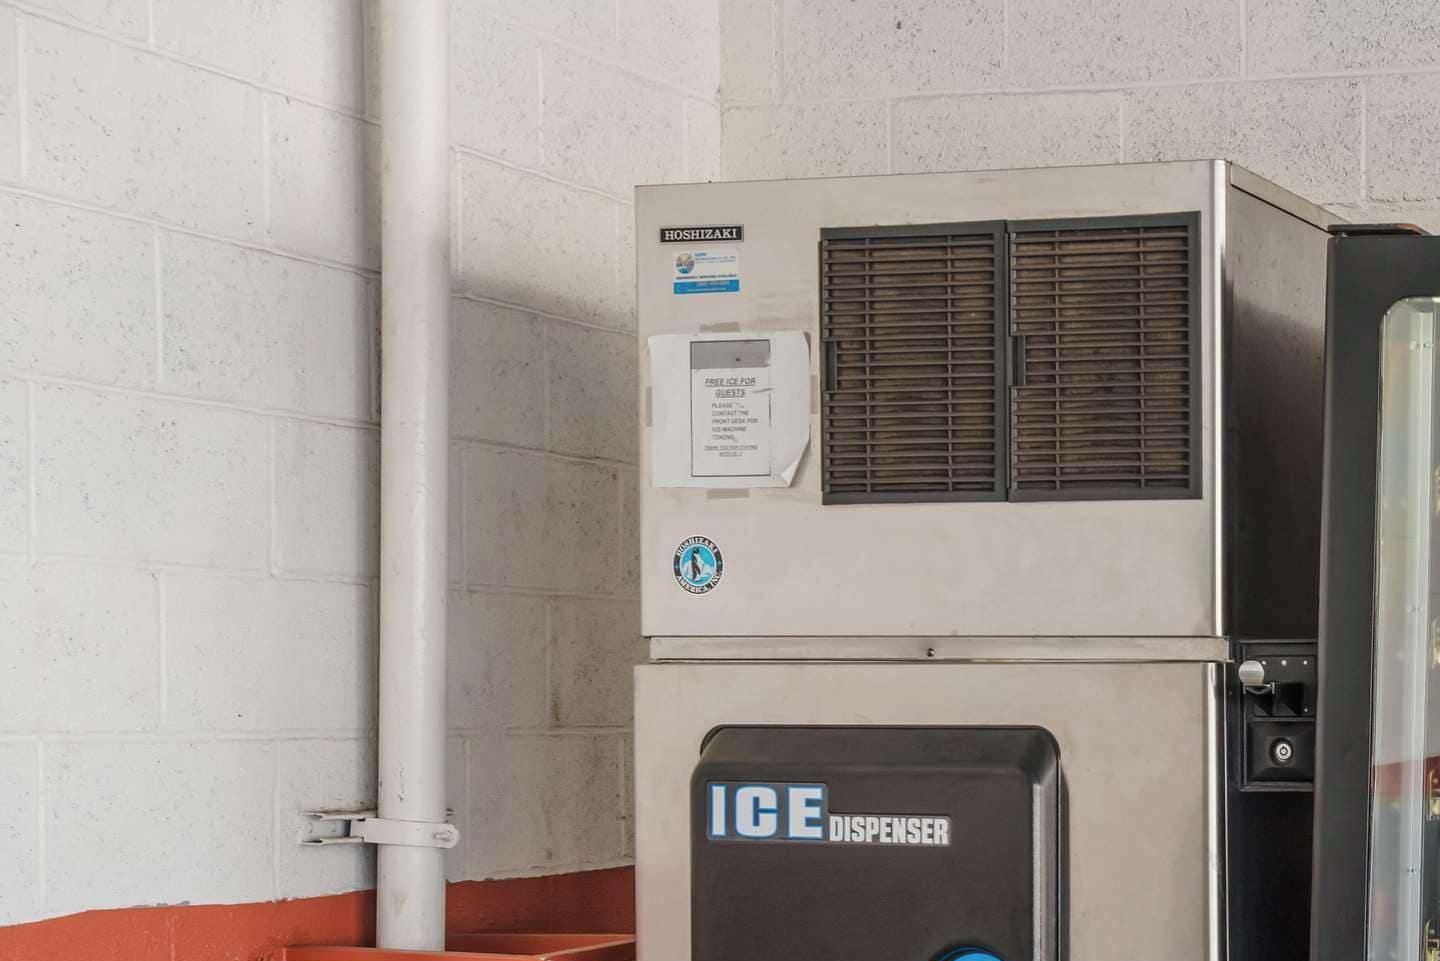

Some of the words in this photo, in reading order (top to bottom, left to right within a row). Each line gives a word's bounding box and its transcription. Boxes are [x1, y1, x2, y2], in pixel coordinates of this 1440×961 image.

[664, 228, 737, 241] HOSHIZAKI
[705, 378, 724, 386] FREE
[740, 377, 756, 385] FOR
[715, 388, 746, 398] GUESTS
[710, 784, 825, 839] ICE
[829, 815, 950, 846] DISPENSER
